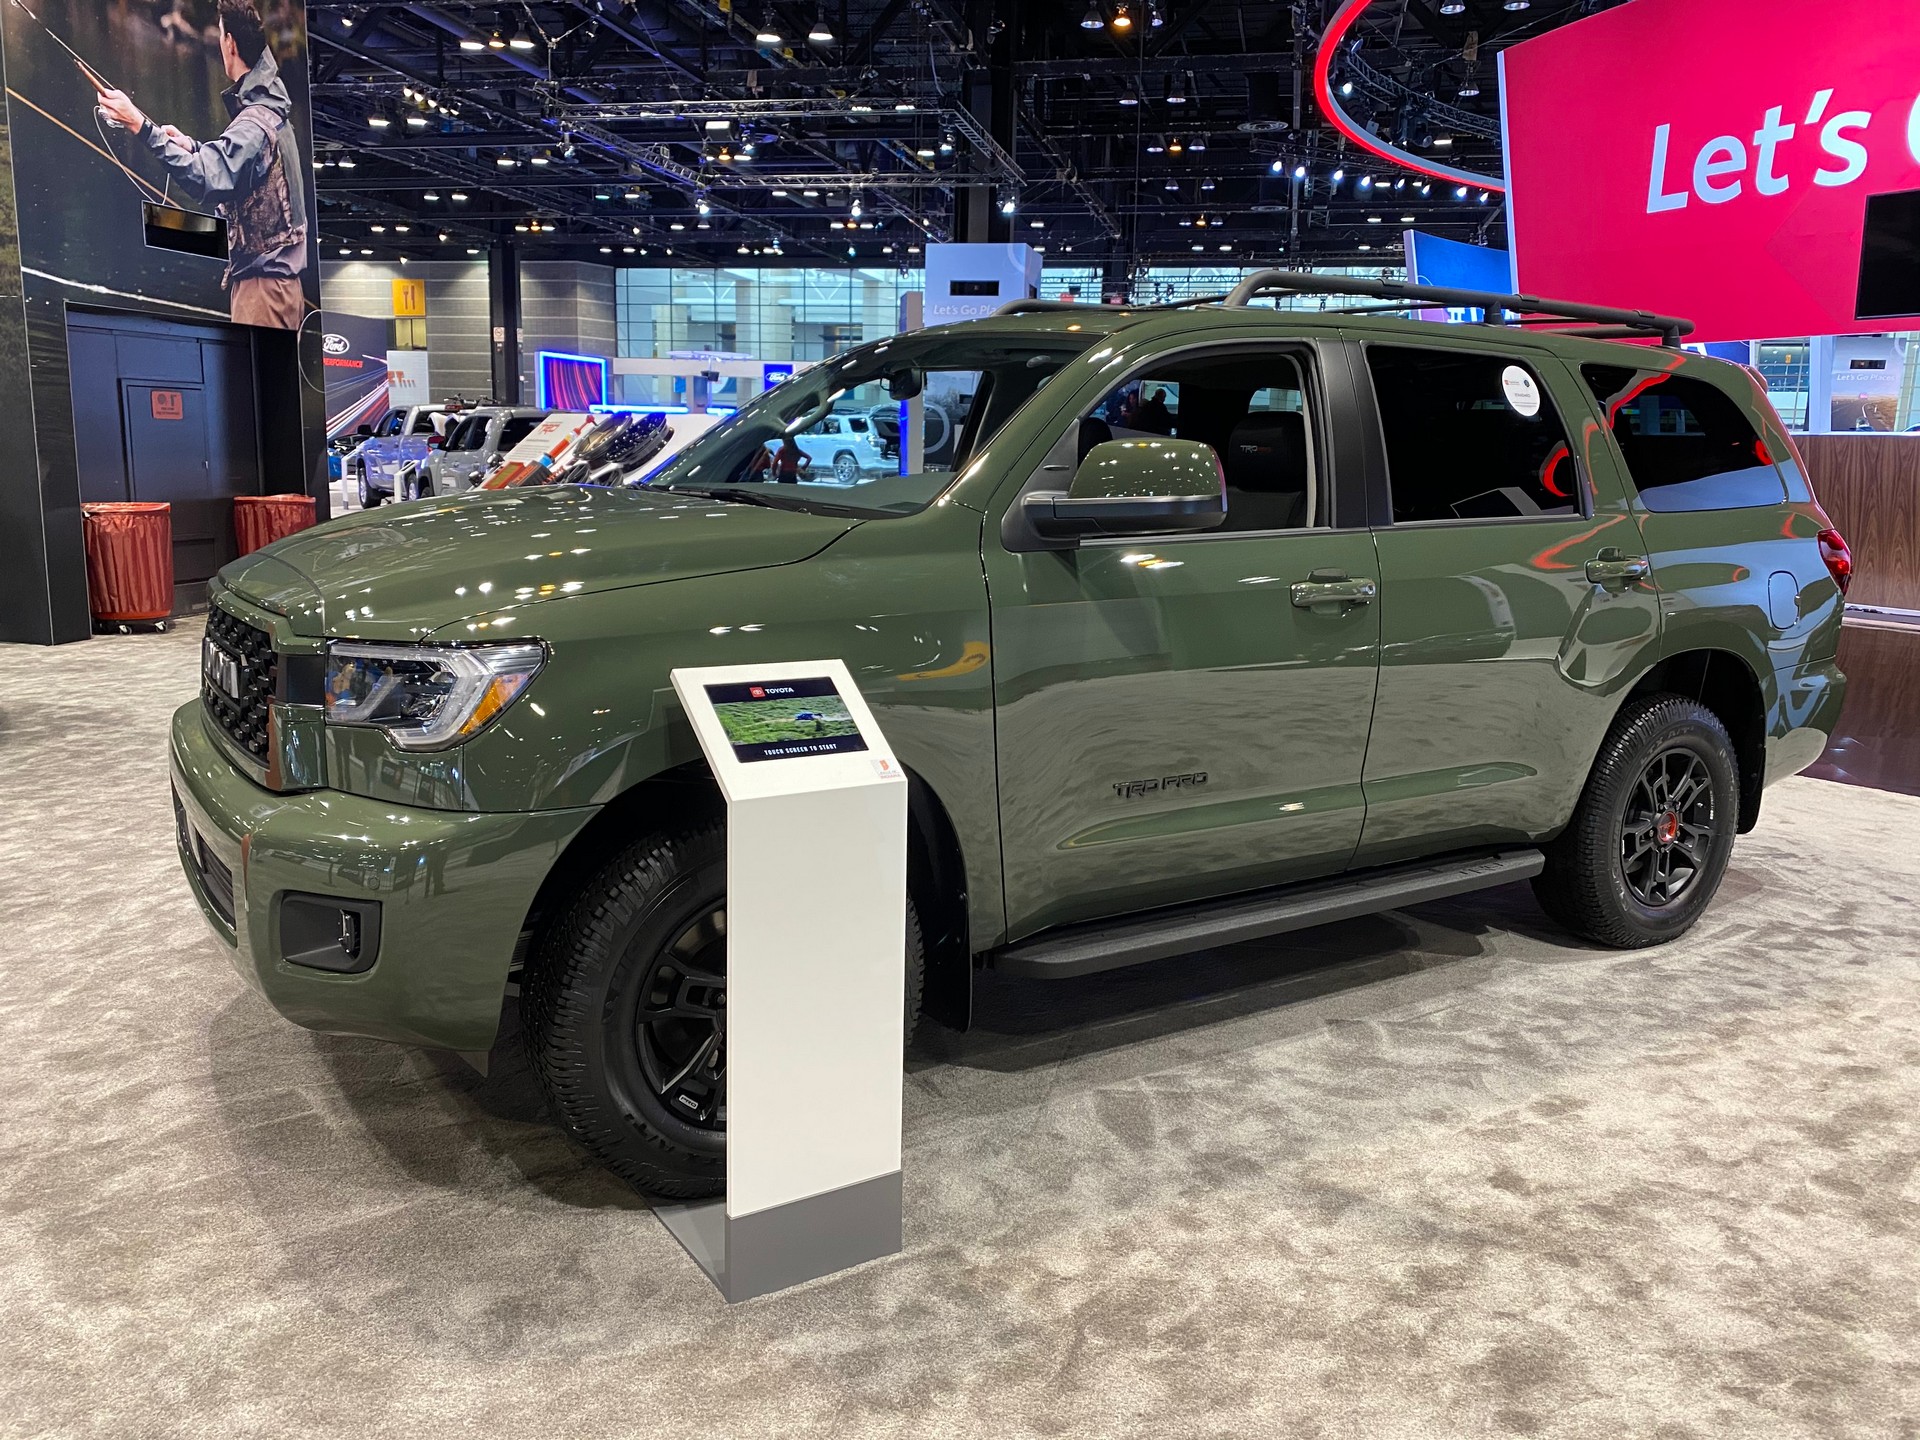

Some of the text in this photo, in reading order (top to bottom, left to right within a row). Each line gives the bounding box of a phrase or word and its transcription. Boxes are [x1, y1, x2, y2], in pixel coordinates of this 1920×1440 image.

[1646, 87, 1872, 214] Let's
[933, 304, 997, 316] Let's Go Pla
[1836, 373, 1896, 381] Let's Go Places
[763, 748, 784, 756] TOUCH
[785, 746, 808, 754] SCREEN
[819, 743, 837, 751] START
[1112, 771, 1209, 799] TRD PRO
